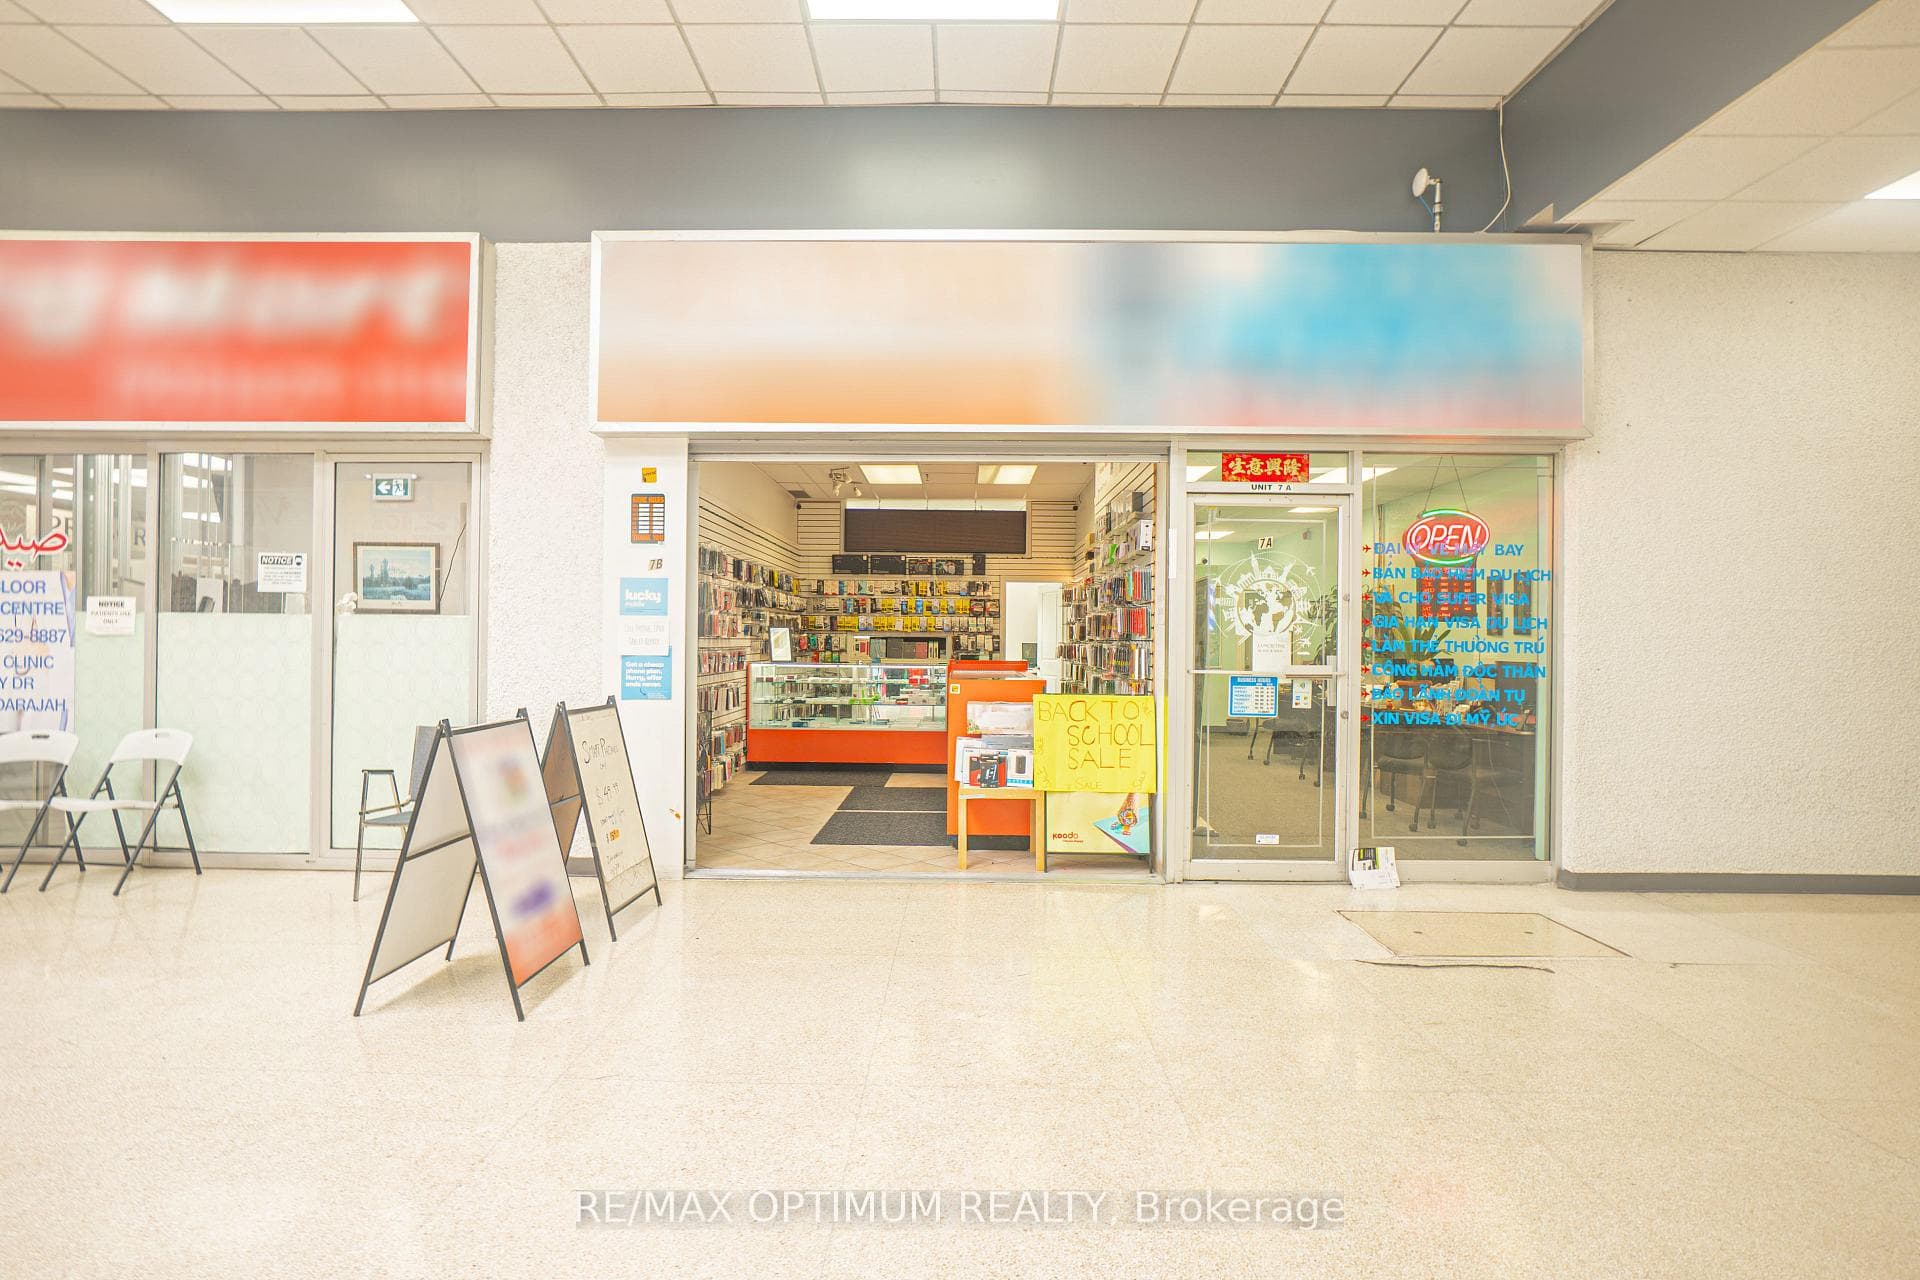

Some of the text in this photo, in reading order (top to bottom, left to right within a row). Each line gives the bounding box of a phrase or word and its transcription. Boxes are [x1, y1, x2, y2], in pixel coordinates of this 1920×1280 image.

[1229, 458, 1301, 475] 生意興隆
[1259, 537, 1272, 549] 7A
[1411, 524, 1481, 550] OPEN
[1495, 544, 1524, 556] BAY
[261, 556, 293, 564] NOTICE
[650, 559, 662, 570] 7B
[1490, 569, 1512, 581] DU
[2, 580, 46, 594] LOOR
[625, 588, 661, 603] lucky
[1398, 591, 1431, 604] CHO
[1436, 592, 1486, 605] SUPER
[1492, 592, 1529, 605] VISA
[1, 601, 64, 615] CENTRE
[1372, 614, 1398, 628] GIA
[1443, 616, 1480, 629] VISA
[1486, 617, 1509, 629] DU
[1513, 636, 1545, 654] TRÚ
[4, 655, 55, 669] CLINIC
[1372, 659, 1417, 676] CÔNG
[1421, 658, 1459, 676] HÀM
[1501, 661, 1546, 678] THÂN
[13, 676, 34, 690] DR
[1039, 700, 1098, 721] BACK
[1103, 701, 1140, 720] TO
[1373, 711, 1400, 725] XIN
[1404, 712, 1441, 725] VISA
[1067, 723, 1154, 746] SCHOOL
[1068, 748, 1132, 770] SALE
